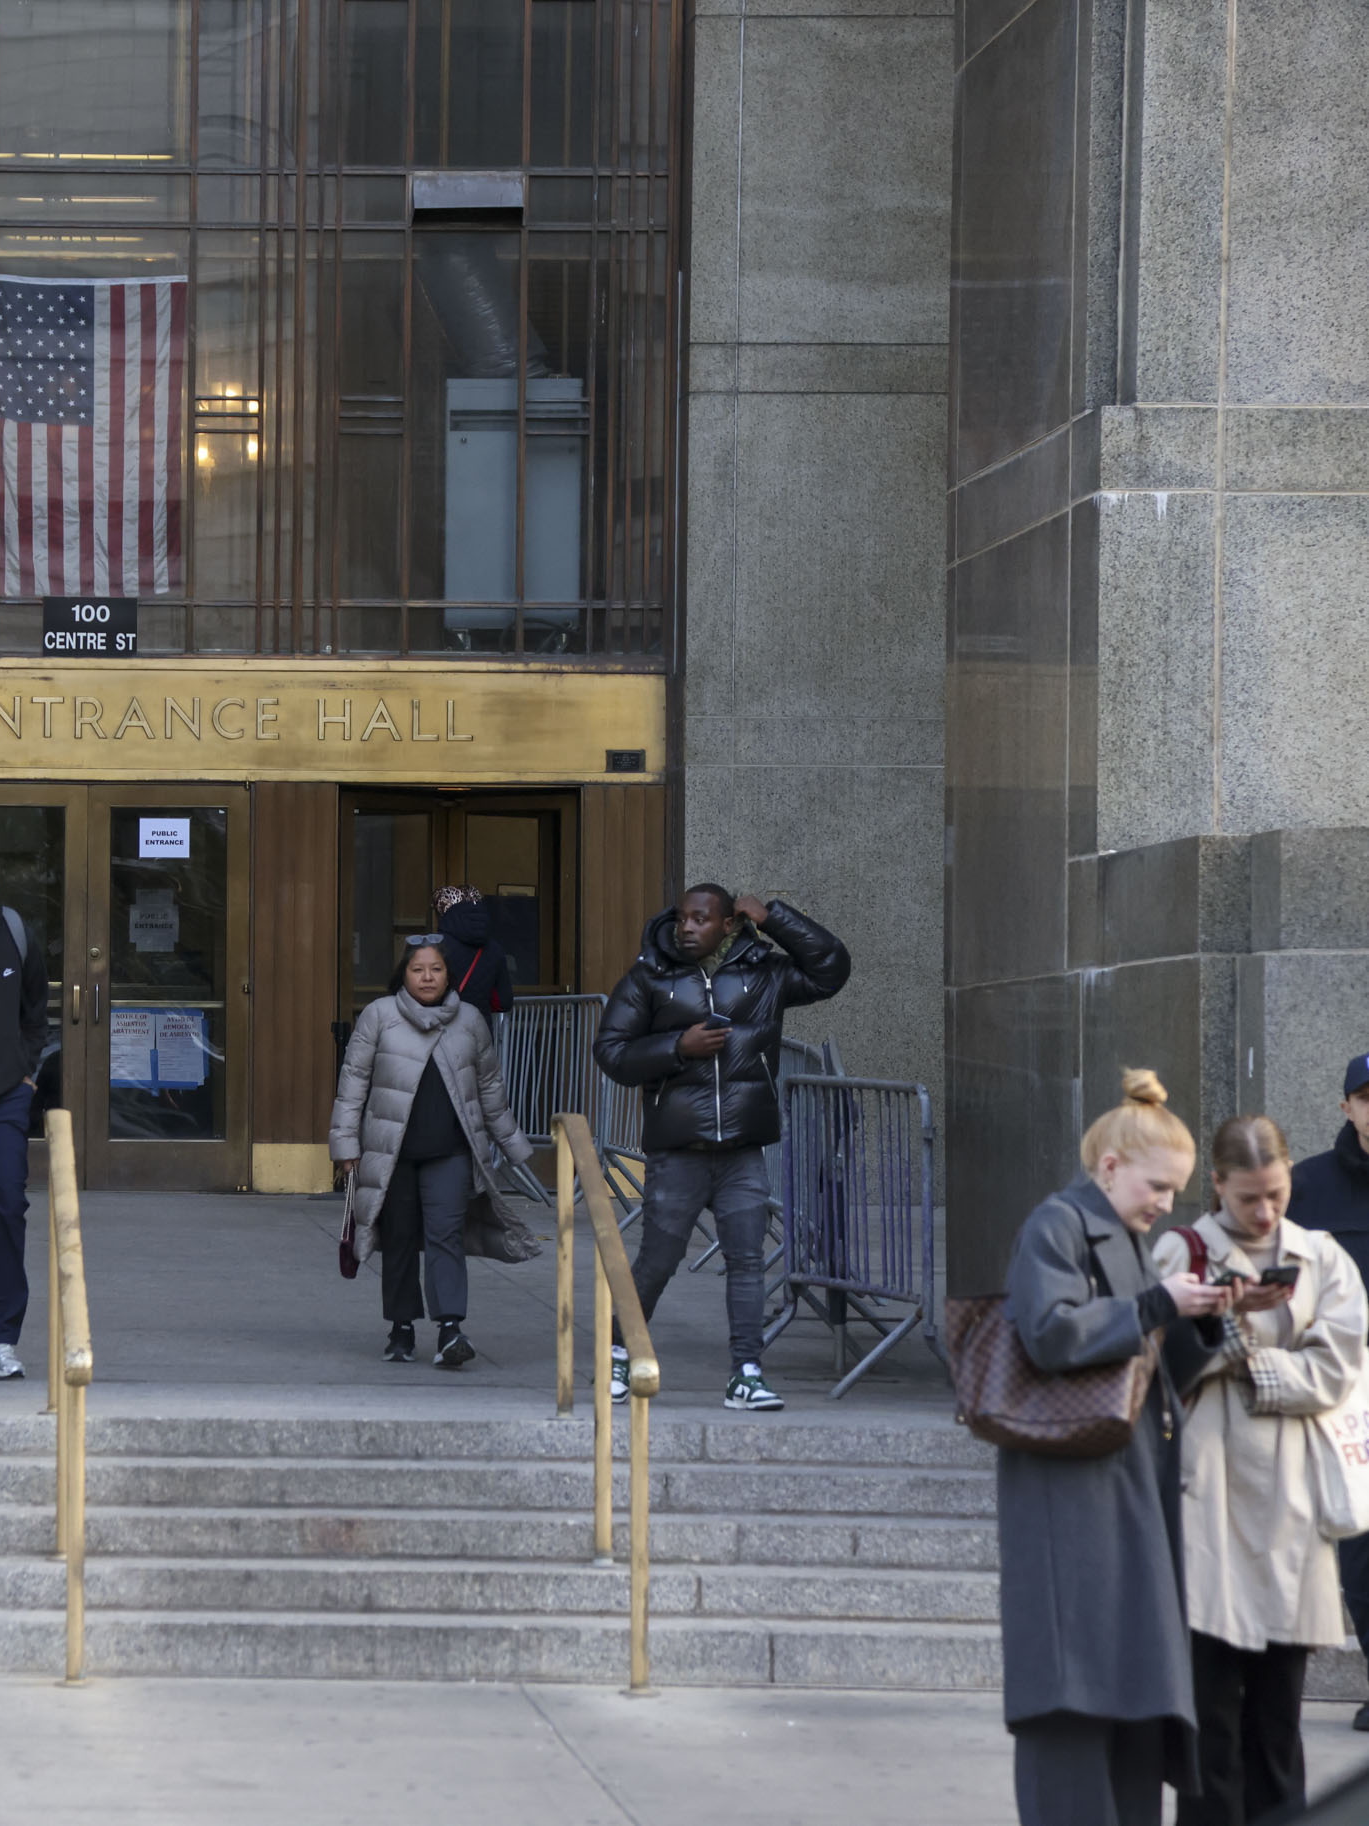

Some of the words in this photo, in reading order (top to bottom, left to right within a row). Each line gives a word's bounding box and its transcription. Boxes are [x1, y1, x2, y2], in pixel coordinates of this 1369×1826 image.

[71, 604, 111, 623] 100
[44, 631, 107, 650] CENTRE
[115, 632, 136, 651] ST
[317, 698, 474, 742] HALL
